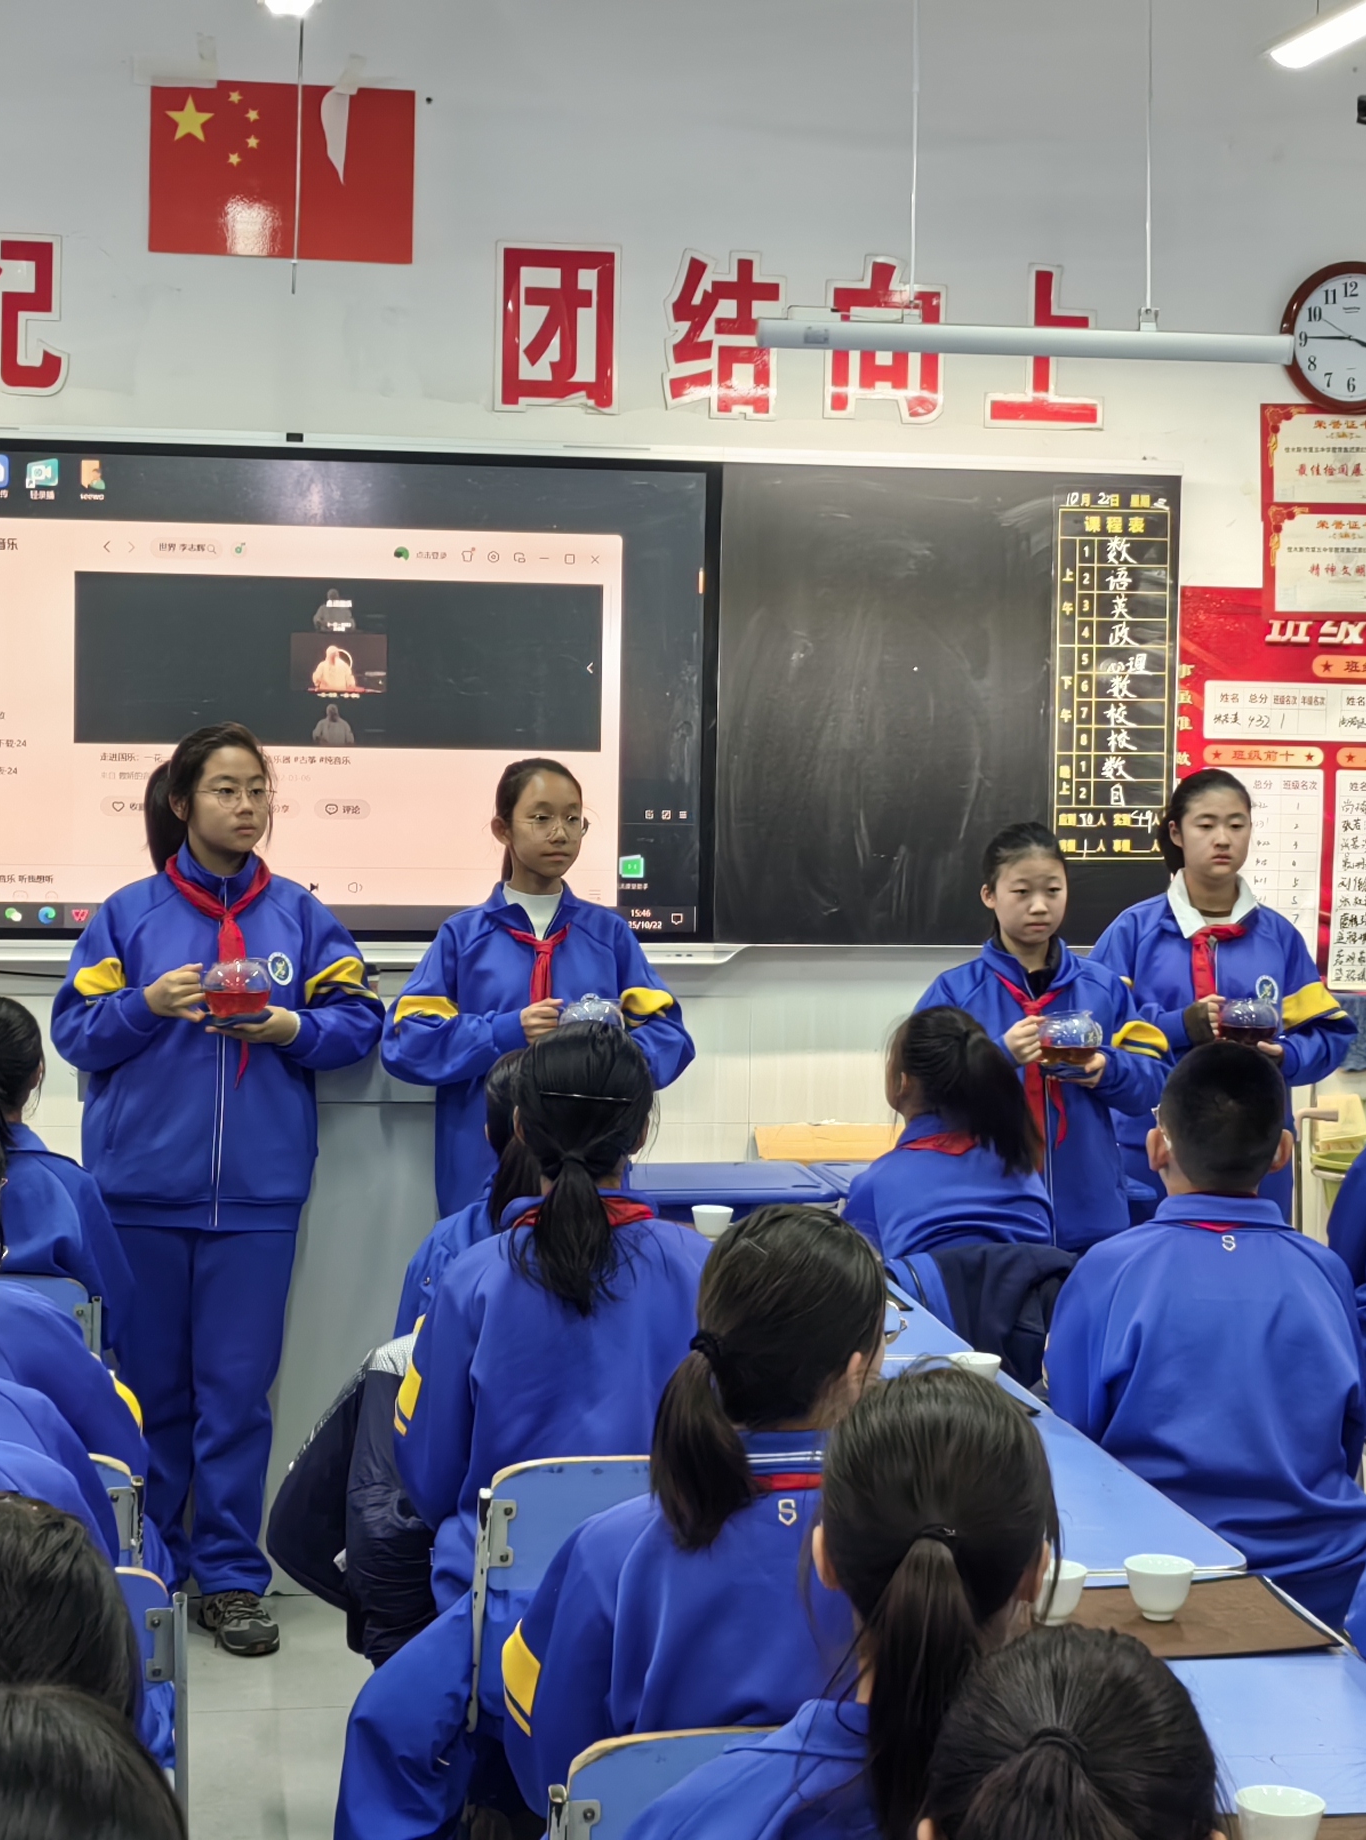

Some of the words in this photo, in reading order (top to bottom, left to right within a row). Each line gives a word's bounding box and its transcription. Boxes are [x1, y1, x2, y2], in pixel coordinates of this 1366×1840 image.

[1342, 281, 1359, 298] 12
[1324, 289, 1337, 305] 11
[1307, 306, 1322, 322] 10
[1299, 331, 1308, 347] 9
[1307, 355, 1317, 371] 8
[1324, 372, 1333, 388] 7
[1347, 377, 1356, 393] 6
[1084, 516, 1145, 533] 课程表
[1083, 546, 1090, 557] 1
[1082, 574, 1090, 584] 2
[1105, 567, 1132, 591] 语
[1062, 568, 1074, 616] 上午
[1082, 600, 1090, 611] 3
[1110, 594, 1134, 620] 英
[1081, 628, 1090, 638] 4
[1108, 622, 1140, 647] 政
[1081, 654, 1089, 665] 5
[1080, 681, 1089, 692] 6
[1060, 676, 1073, 723] 下午
[1219, 693, 1240, 704] 姓名
[1248, 693, 1268, 704] 总分
[1346, 696, 1366, 707] 姓名
[1080, 707, 1089, 718] 7
[1103, 703, 1137, 727] 校
[1080, 734, 1088, 745] 8
[1232, 750, 1295, 761] 班级前十
[1080, 761, 1087, 772] 1
[1253, 780, 1273, 790] 总分
[1283, 780, 1318, 791] 班级名次
[1079, 788, 1087, 798] 2
[342, 805, 360, 815] 评论
[631, 909, 651, 918] 15:46
